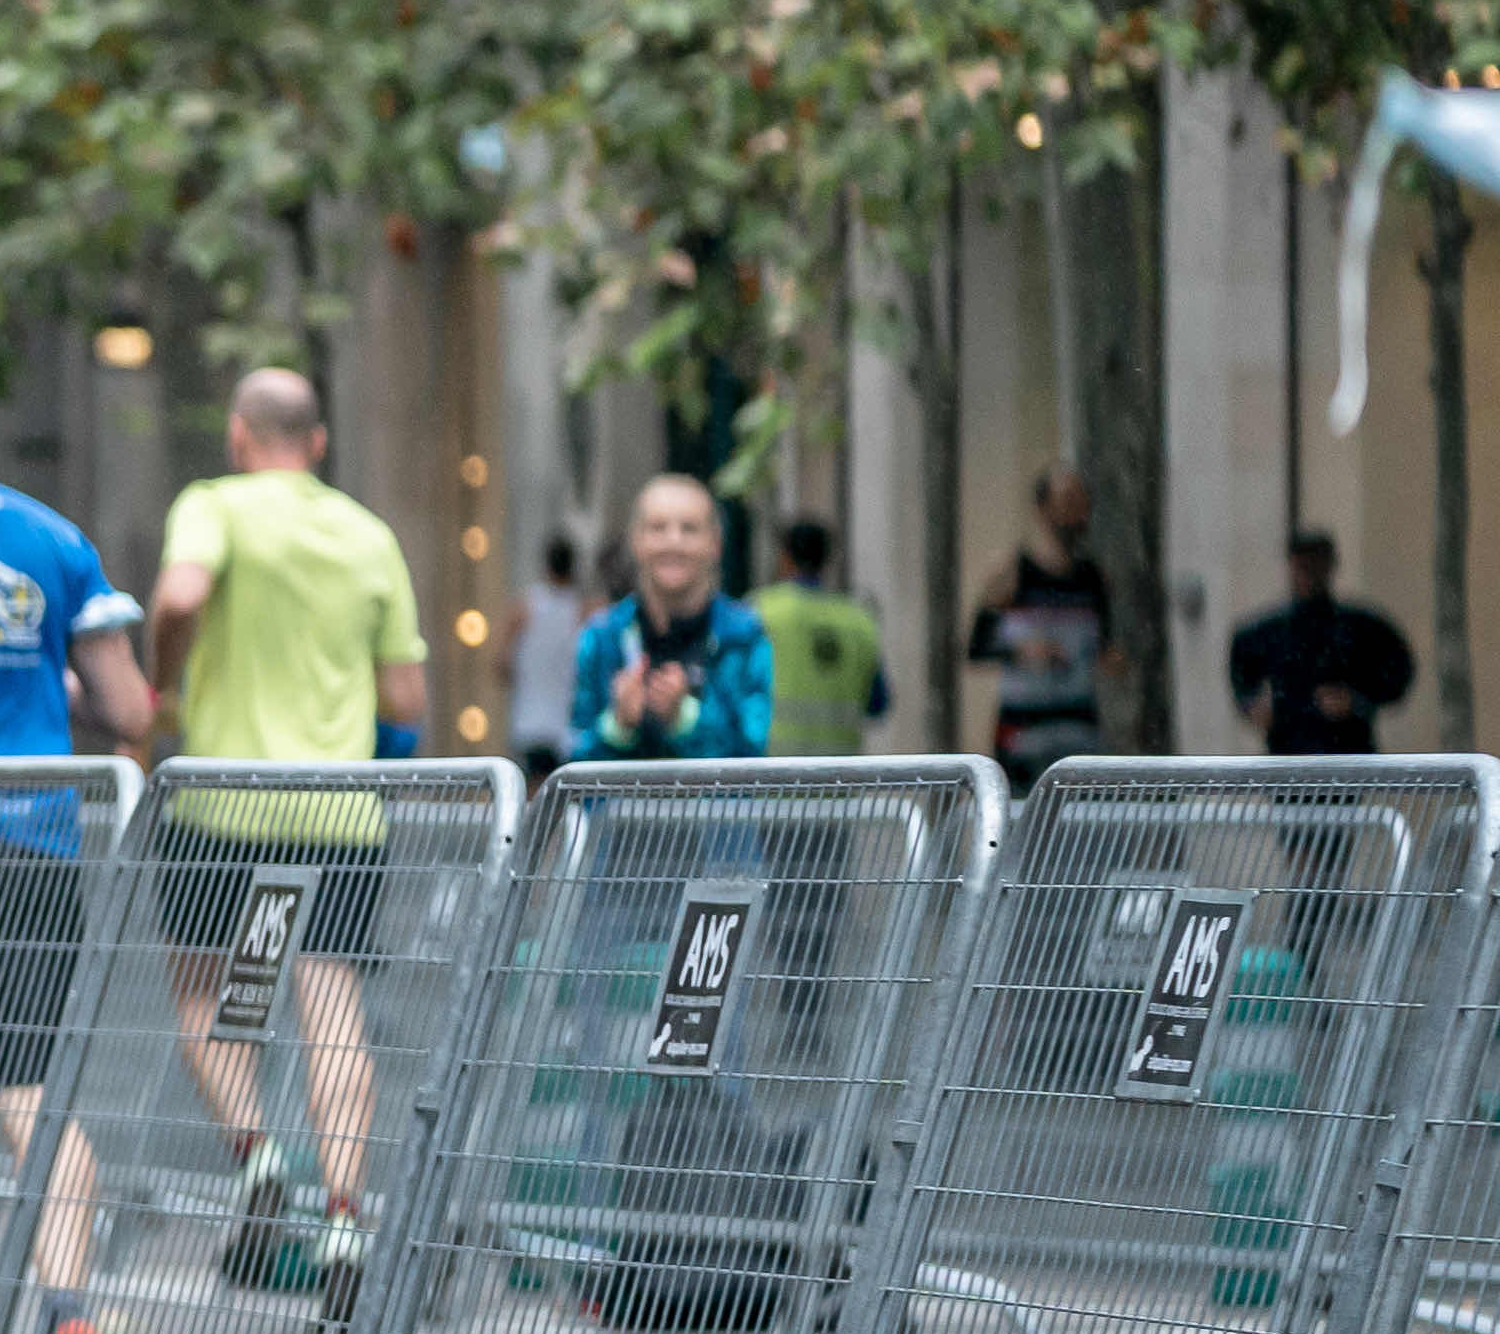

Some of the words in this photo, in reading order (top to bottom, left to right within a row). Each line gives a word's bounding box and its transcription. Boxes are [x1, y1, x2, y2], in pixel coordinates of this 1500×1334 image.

[242, 893, 296, 962] AMS
[678, 912, 740, 989] AMS
[1162, 914, 1232, 998] AMS
